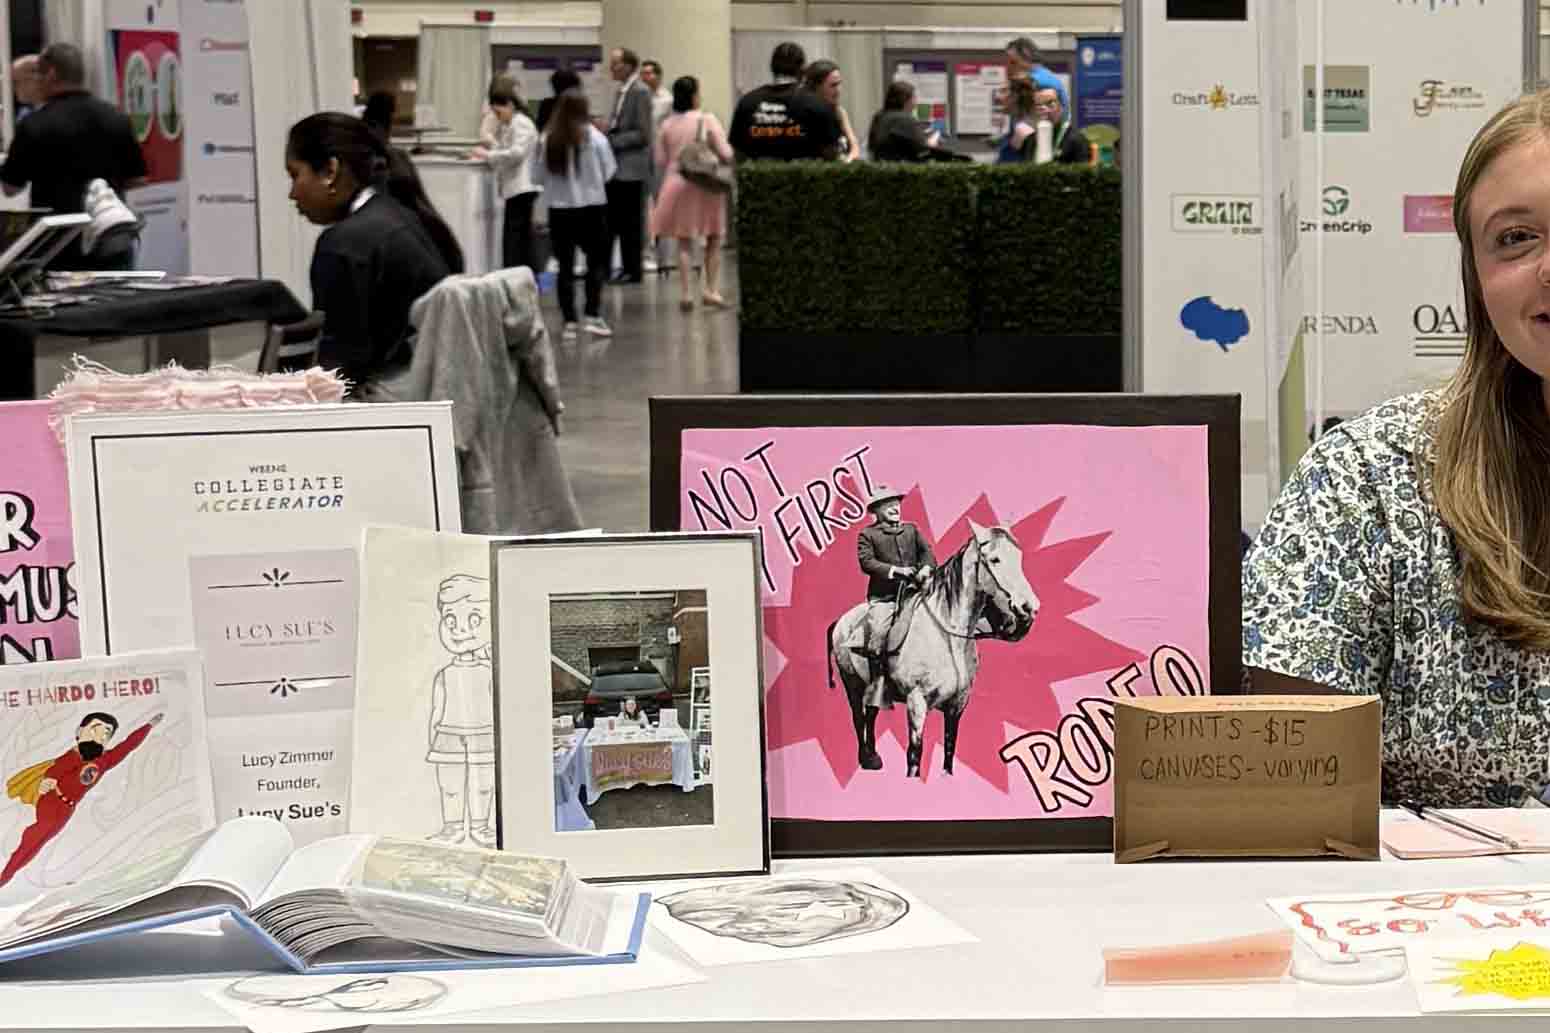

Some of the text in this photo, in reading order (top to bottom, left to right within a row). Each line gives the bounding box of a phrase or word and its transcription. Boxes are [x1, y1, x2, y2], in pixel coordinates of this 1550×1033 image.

[194, 476, 344, 495] COLLEGIATE
[688, 440, 775, 531] NOT
[196, 494, 344, 513] ACCELERATOR
[774, 445, 873, 563] FIRST
[28, 683, 95, 707] HAIRDO
[103, 676, 160, 699] HERO!
[1144, 715, 1243, 741] PRINTS
[242, 749, 335, 768] Lucy Zimmer
[1263, 754, 1339, 786] varying
[288, 801, 342, 820] Sue's
